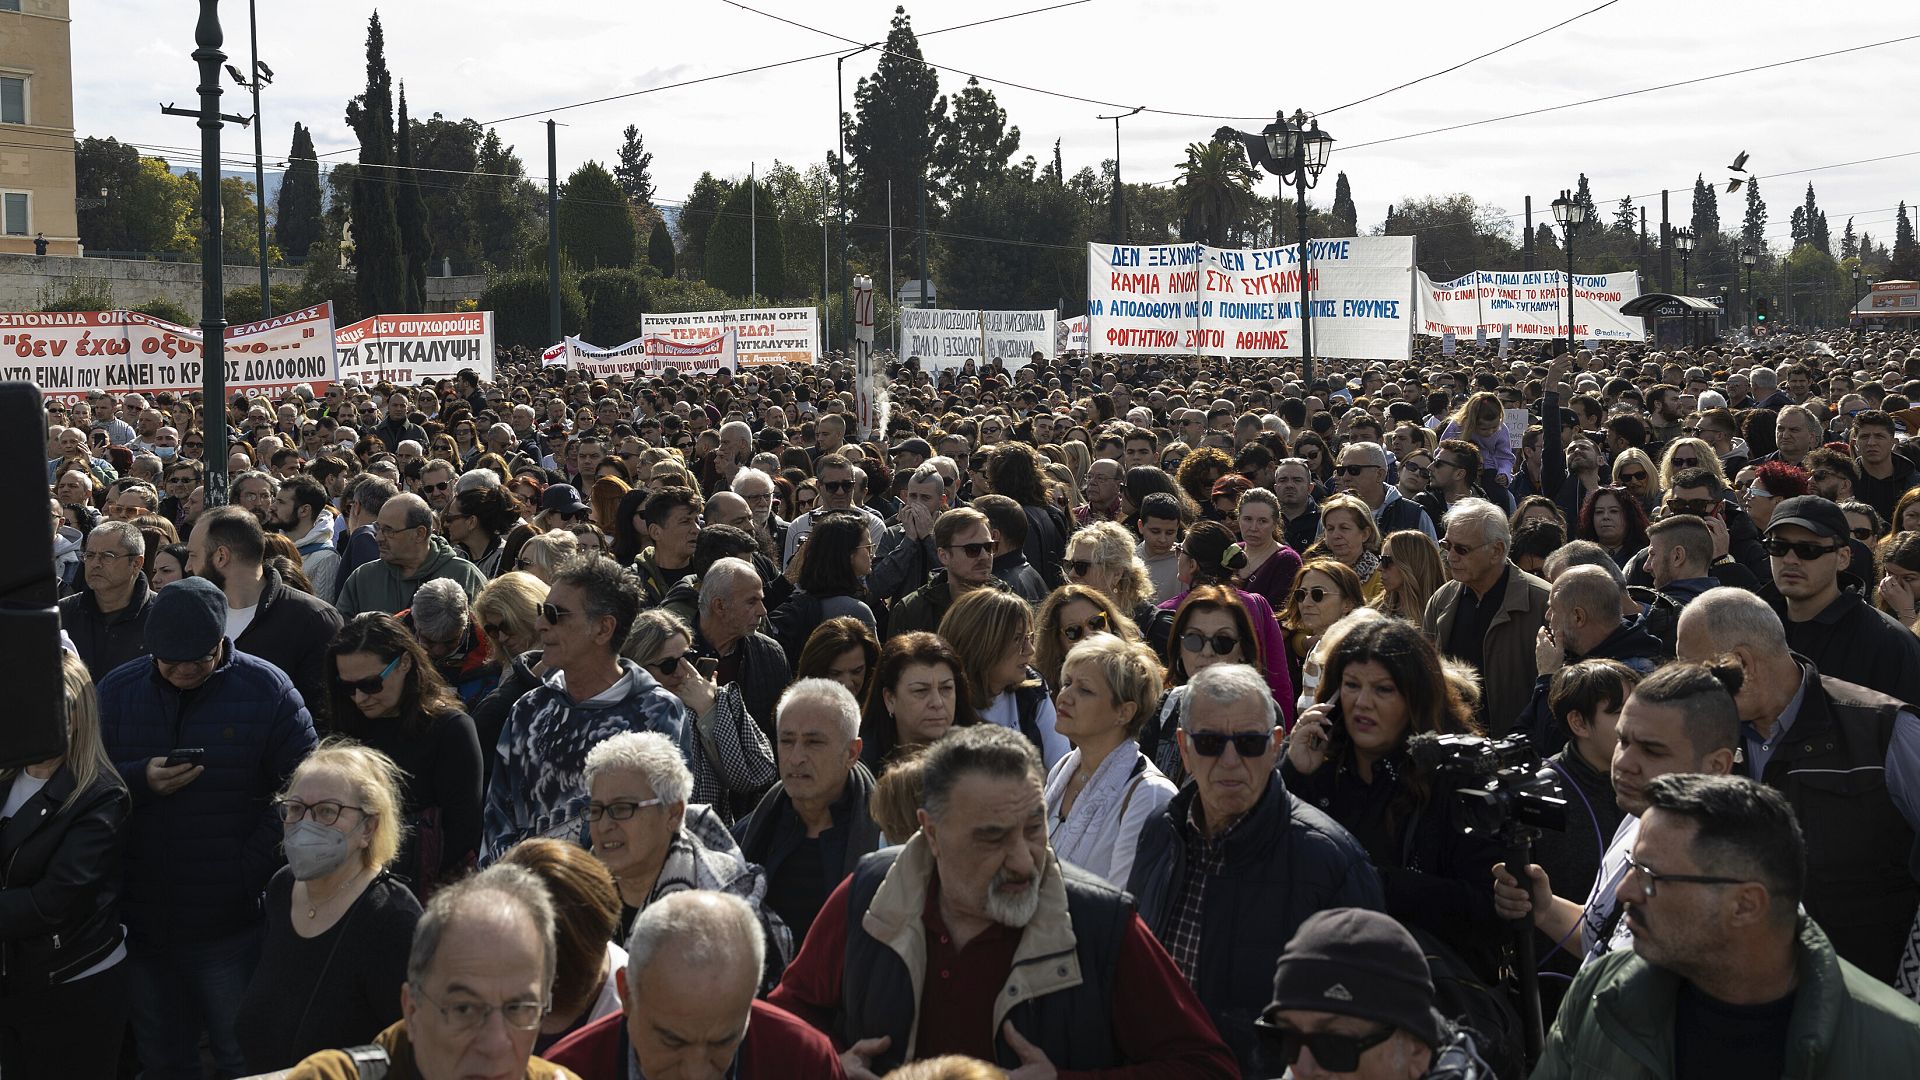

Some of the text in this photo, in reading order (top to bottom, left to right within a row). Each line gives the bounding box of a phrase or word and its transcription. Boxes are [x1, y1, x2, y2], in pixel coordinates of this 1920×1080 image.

[1111, 247, 1140, 266] ΔΕΝ
[1219, 252, 1245, 271] ΔΕΝ
[1111, 272, 1160, 294] ΚΑΜΙΑ
[1495, 273, 1519, 285] ΠΑΙΔΙ
[1522, 273, 1541, 285] ΔΕΝ
[1544, 270, 1560, 284] ΕΧΩ
[1562, 274, 1607, 288] ΟΥΓΟΝΟ
[1454, 289, 1476, 300] ΕΙΝΑΙ
[1478, 287, 1495, 299] ΠΟΥ
[1525, 290, 1537, 299] ΤΟ
[692, 316, 706, 324] ΤΑ
[739, 312, 777, 321] ΕΓΙΝΑΝ
[778, 311, 808, 321] ΟΡΓΗ
[1088, 300, 1103, 315] ΝΑ
[1110, 300, 1181, 319] ΑΠΟΔΟΘΟΥΝ
[1202, 301, 1213, 317] ΟΙ
[1219, 301, 1274, 320] ΠΟΙΝΙΚΕΣ
[1277, 302, 1292, 319] ΚΑΙ
[1343, 300, 1400, 319] ΕΥΘΥΝΕΣ
[232, 307, 320, 336] ΕΛΛΑΔΑΣ
[399, 316, 481, 336] συγχωρούμε
[1558, 324, 1590, 336] ΑΘΝΑΣ
[671, 327, 720, 340] ΤΕΡΜΑ
[738, 324, 775, 337] ΕΔΩ!
[1106, 328, 1179, 347] ΦΟΙΤΗΤΙΚΟΙ
[1235, 331, 1289, 349] ΑΘΗΝΑΣ
[75, 329, 131, 357] έχω
[364, 338, 481, 365] ΣΥΓΚΑΛΥΨΗ
[36, 365, 74, 389] ΕΙΝΑΙ
[105, 363, 154, 387] ΚΑΝΕΙ
[158, 365, 176, 385] ΤΟ
[244, 355, 326, 382] ΔΟΛΟΦΟΝΟ
[693, 356, 720, 371] φωνή
[347, 368, 413, 385] ΕΤΗΠ
